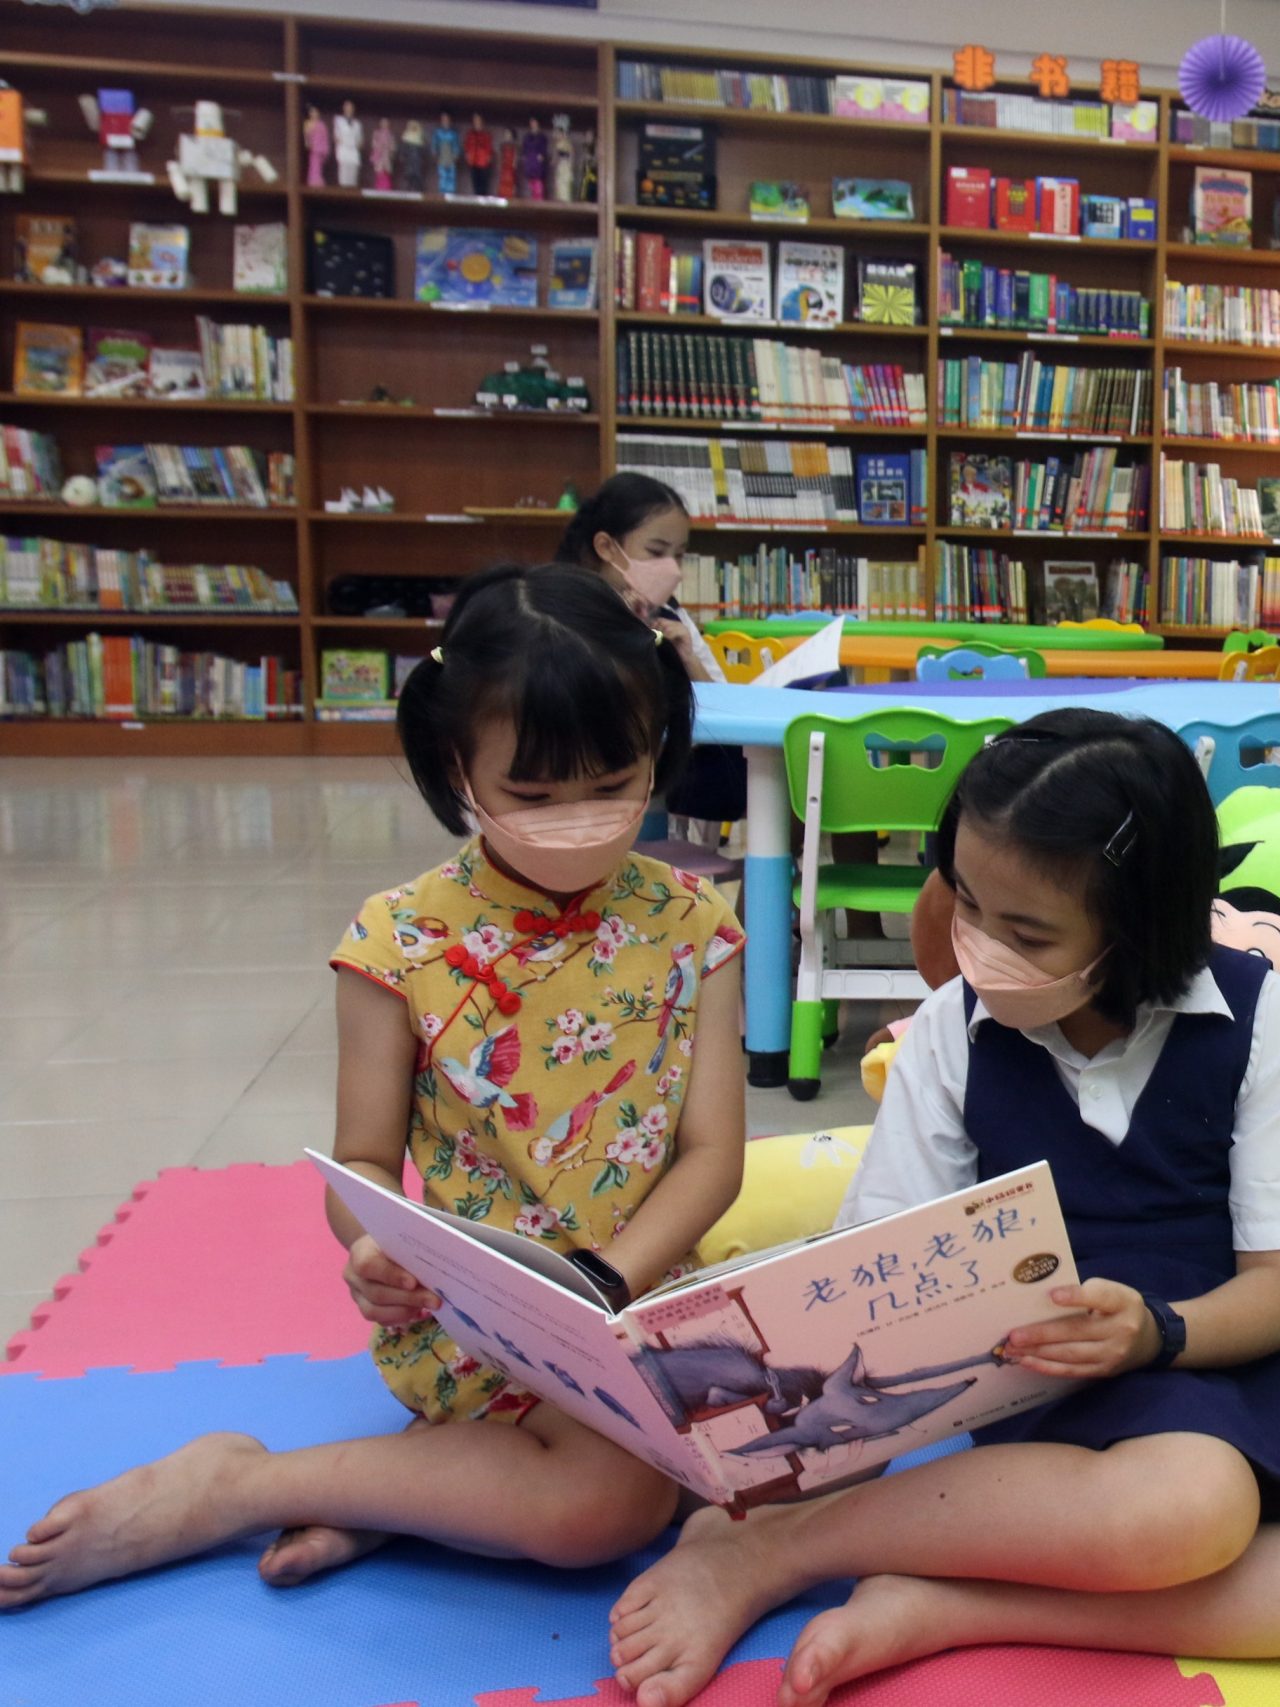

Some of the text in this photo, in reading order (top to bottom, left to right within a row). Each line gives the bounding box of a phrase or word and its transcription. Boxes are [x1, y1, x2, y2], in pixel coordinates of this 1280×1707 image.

[953, 44, 1140, 105] 非书籍
[868, 1260, 980, 1320] 几点了
